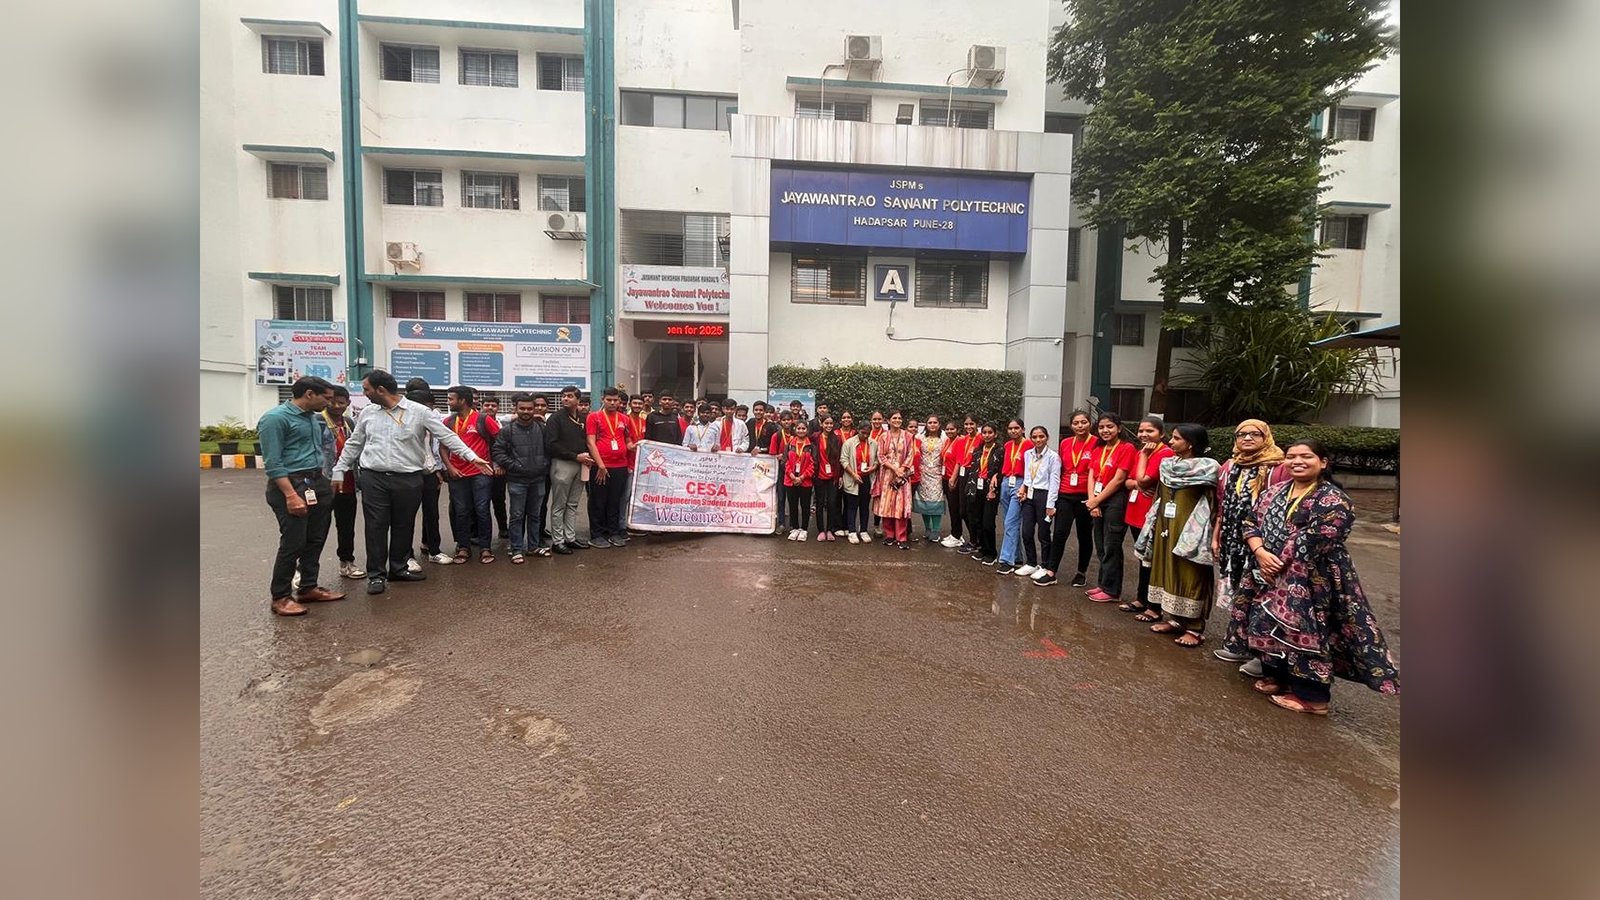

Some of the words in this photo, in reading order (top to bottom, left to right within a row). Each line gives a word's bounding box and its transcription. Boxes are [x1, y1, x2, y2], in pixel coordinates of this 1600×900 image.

[890, 180, 916, 190] JSPM
[781, 191, 877, 208] JAYAWANTRAO
[883, 196, 939, 211] SAWANT
[943, 199, 1025, 215] POLYTECHNIC
[853, 216, 908, 228] HADAPSAR
[913, 218, 954, 230] PUNE-28
[880, 269, 905, 294] A
[627, 287, 670, 299] Jayawantrao
[671, 288, 697, 299] Sawant
[644, 300, 694, 311] Welcomes
[696, 302, 714, 311] You
[433, 325, 482, 333] JAYAWANTRAO
[684, 325, 698, 335] for
[698, 325, 724, 335] 2025
[521, 345, 561, 353] ADMISSION
[561, 346, 581, 354] OPEN
[685, 480, 728, 497] CESA
[642, 493, 660, 504] Civil
[661, 494, 701, 507] Engineering
[702, 498, 726, 508] Student
[727, 499, 766, 509] Association
[655, 507, 724, 523] Welcomes
[726, 510, 753, 525] You
